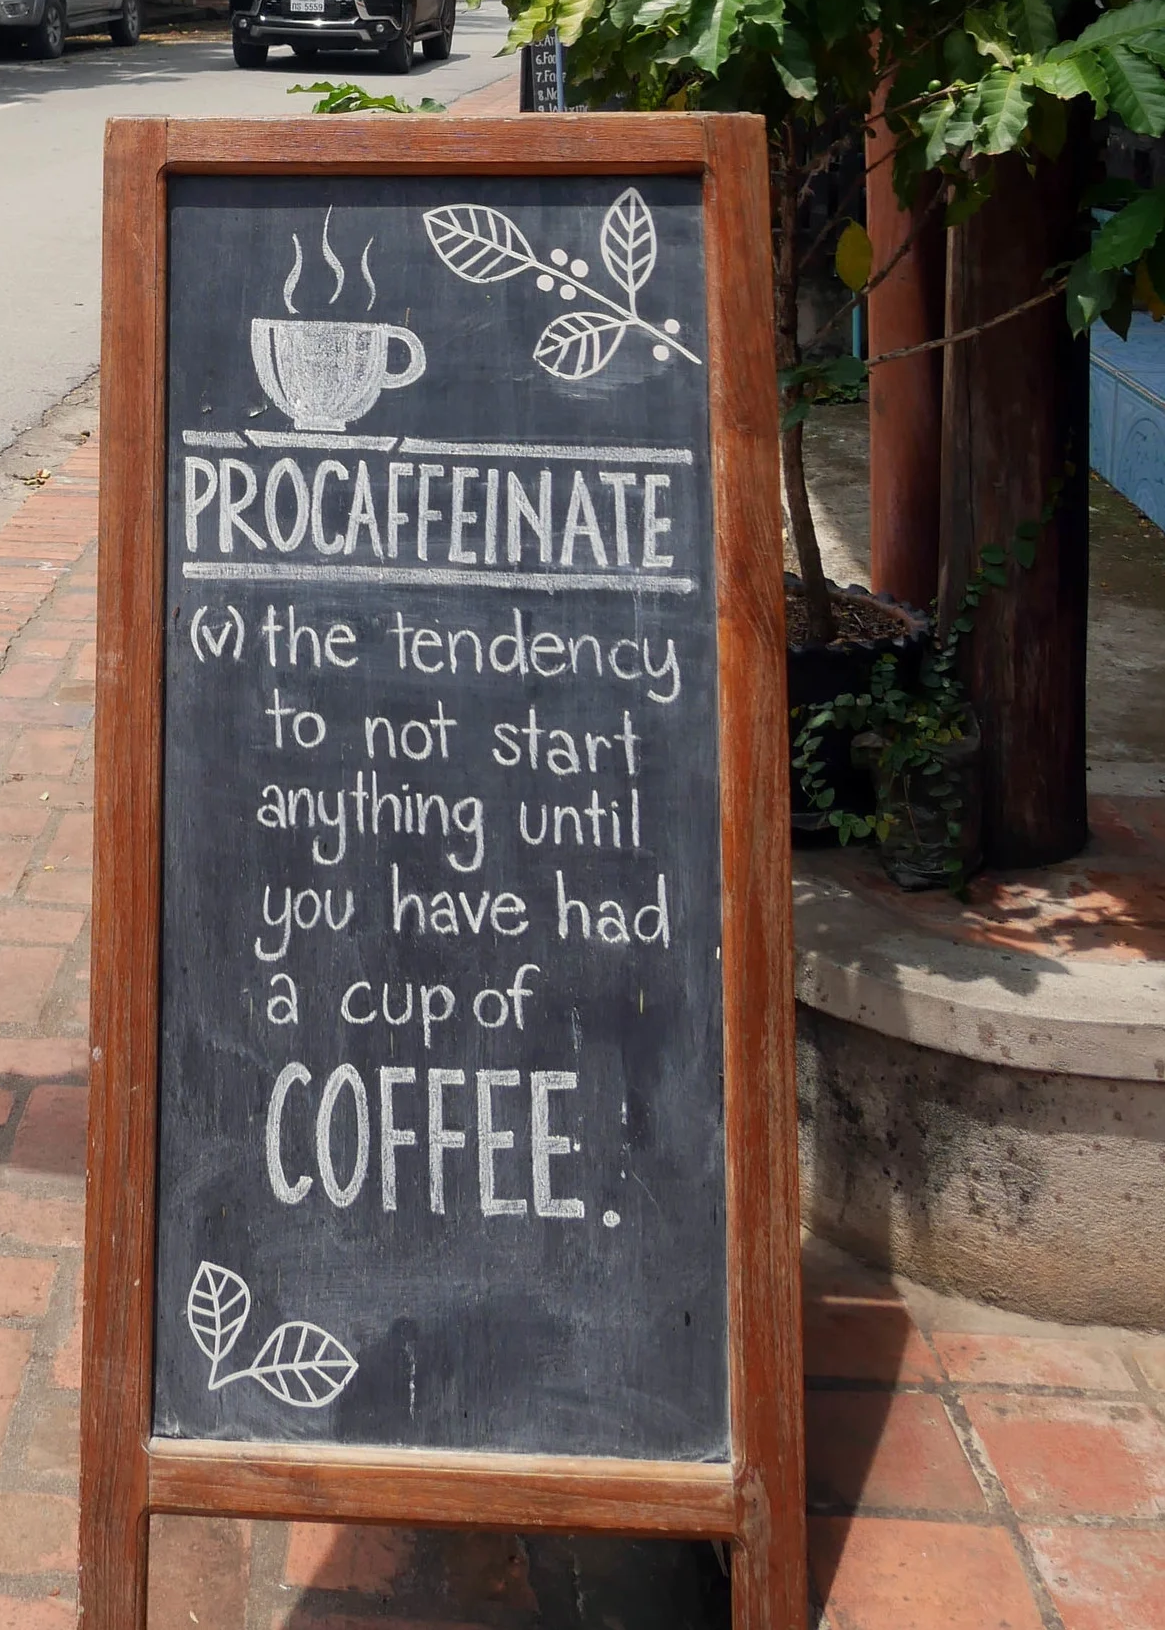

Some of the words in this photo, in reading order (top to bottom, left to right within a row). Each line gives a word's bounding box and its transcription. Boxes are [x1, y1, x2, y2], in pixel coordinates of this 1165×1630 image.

[304, 2, 323, 11] 5559
[184, 456, 675, 569] PROCAFFEINATE
[190, 604, 246, 663] (v)
[262, 604, 358, 668] the
[390, 606, 682, 703] tendency
[265, 688, 326, 749] to
[364, 700, 458, 760] not
[492, 704, 643, 775] start
[256, 770, 486, 871] anything
[519, 788, 641, 848] until
[254, 884, 356, 962] you
[391, 862, 530, 936] have
[556, 870, 671, 948] had
[266, 972, 299, 1025] a
[340, 980, 457, 1049] cup
[473, 963, 541, 1029] of
[265, 1061, 621, 1228] COFFEE.
